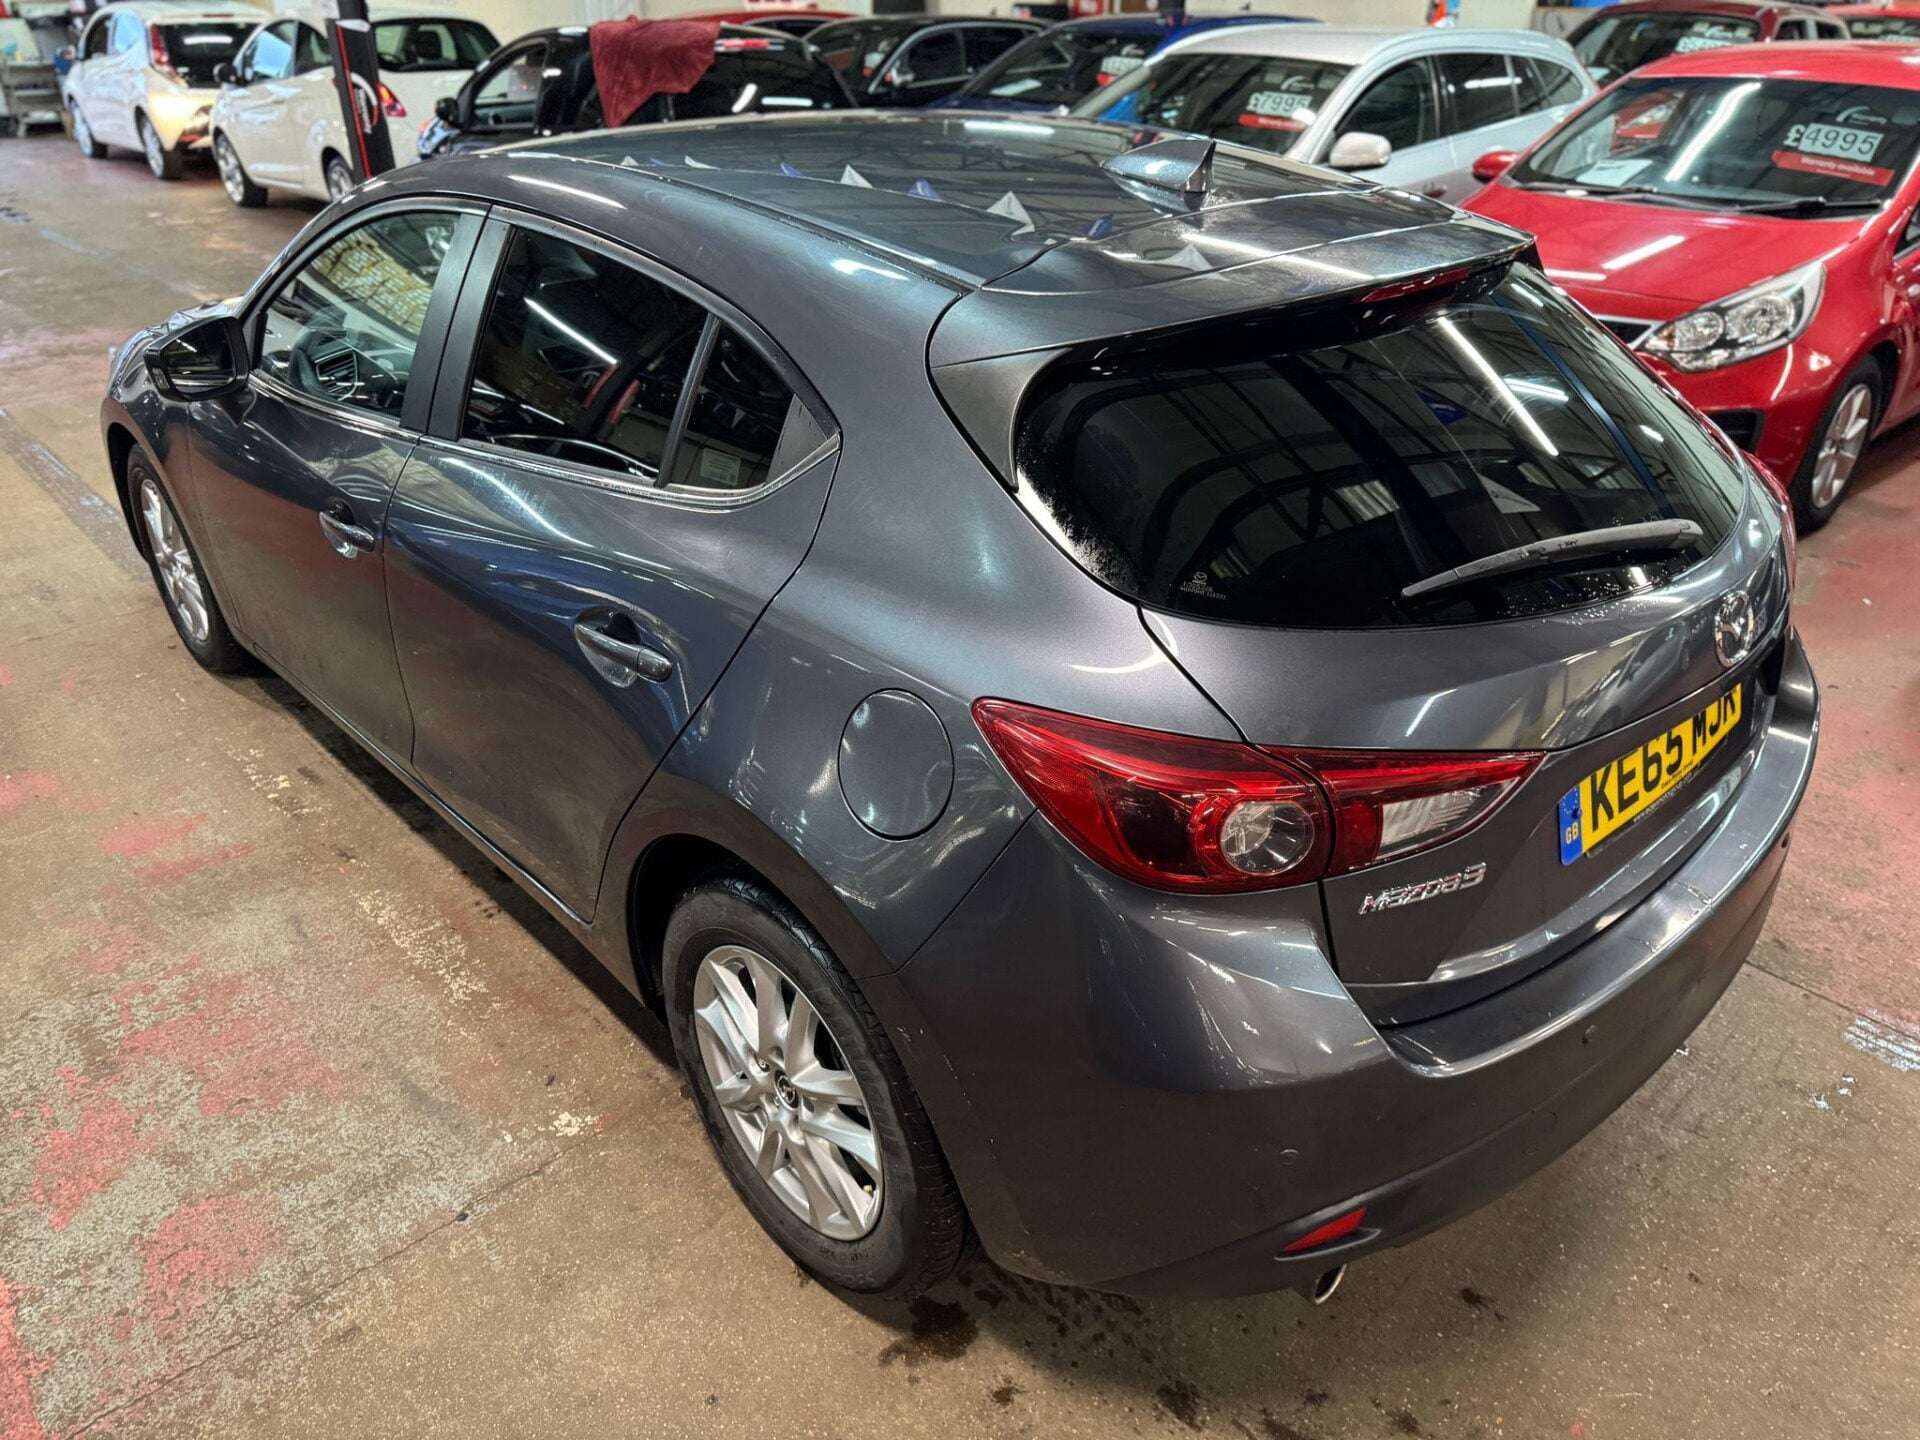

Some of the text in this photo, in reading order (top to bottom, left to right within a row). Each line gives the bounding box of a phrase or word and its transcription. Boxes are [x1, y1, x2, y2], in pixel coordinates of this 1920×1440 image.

[1783, 124, 1881, 156] £4995
[1590, 731, 1684, 833] KE65
[1565, 821, 1580, 845] GB
